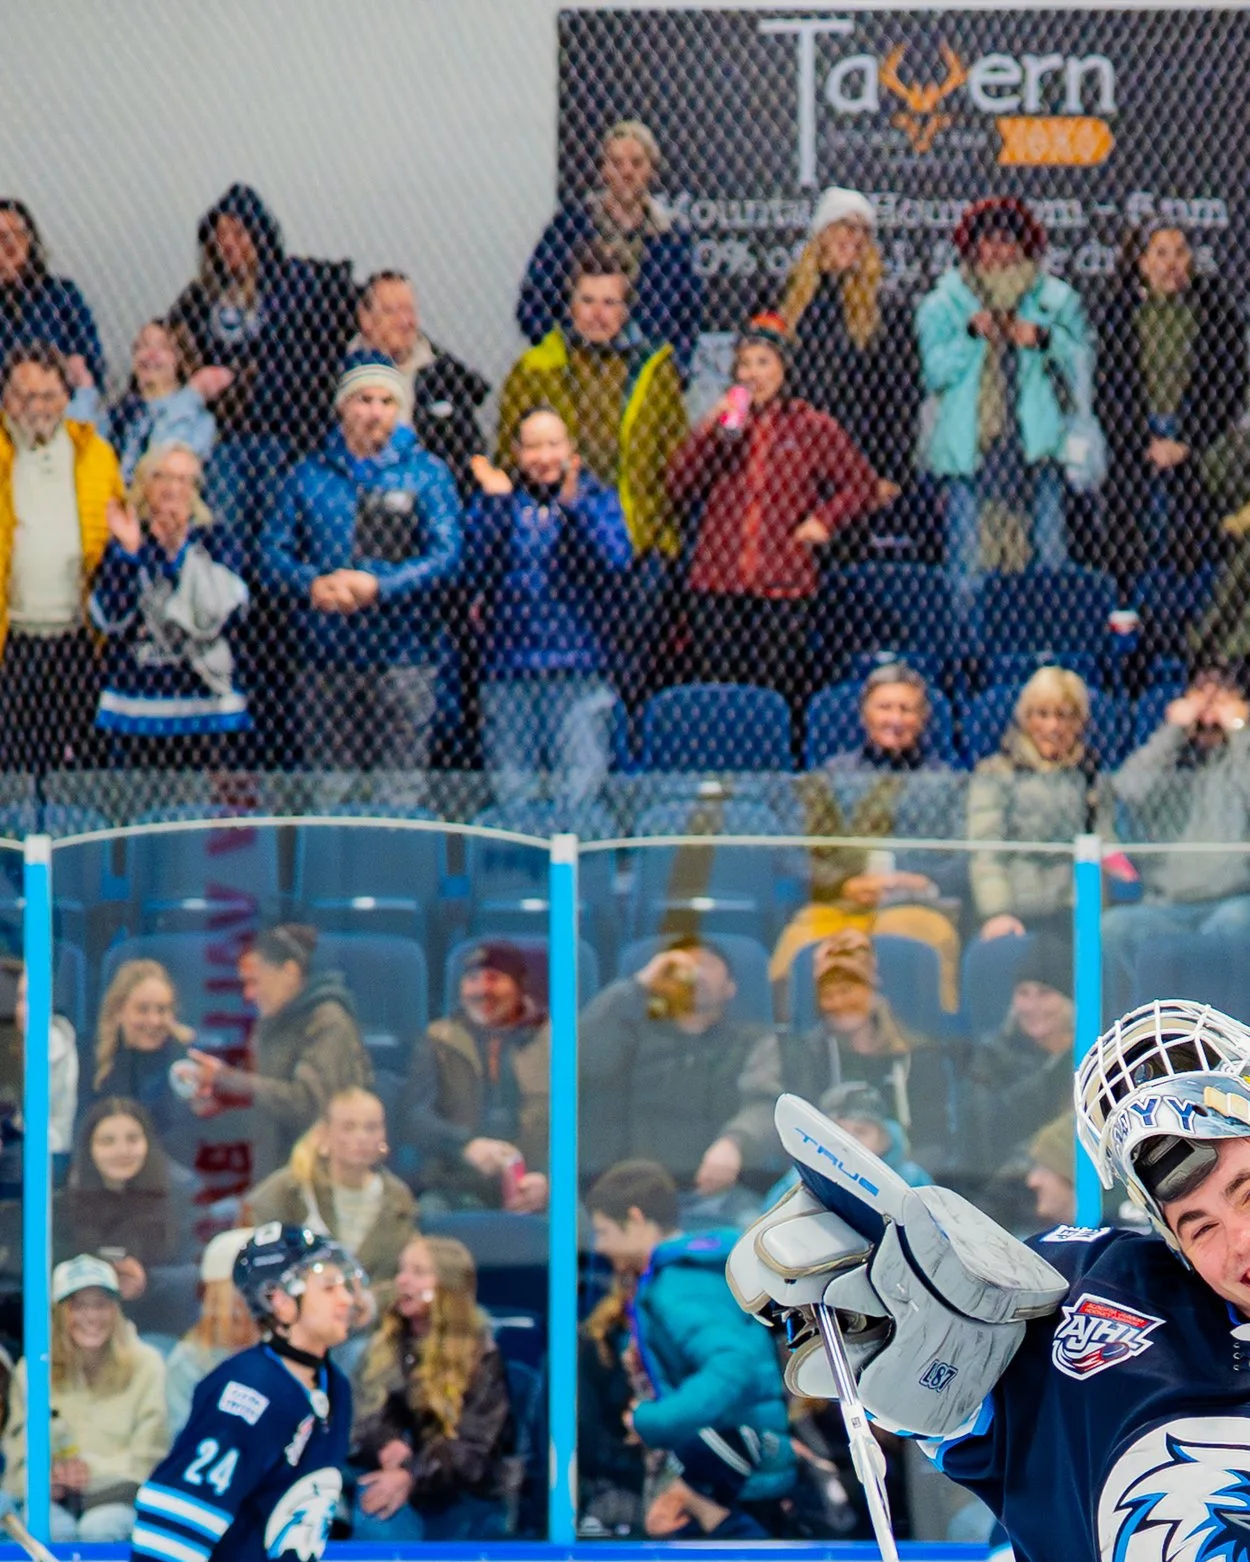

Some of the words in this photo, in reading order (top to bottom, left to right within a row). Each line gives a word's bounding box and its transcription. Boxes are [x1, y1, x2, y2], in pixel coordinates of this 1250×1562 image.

[794, 1128, 880, 1198] TRUE
[1057, 1314, 1142, 1351] AJHL
[183, 1437, 240, 1497] 24
